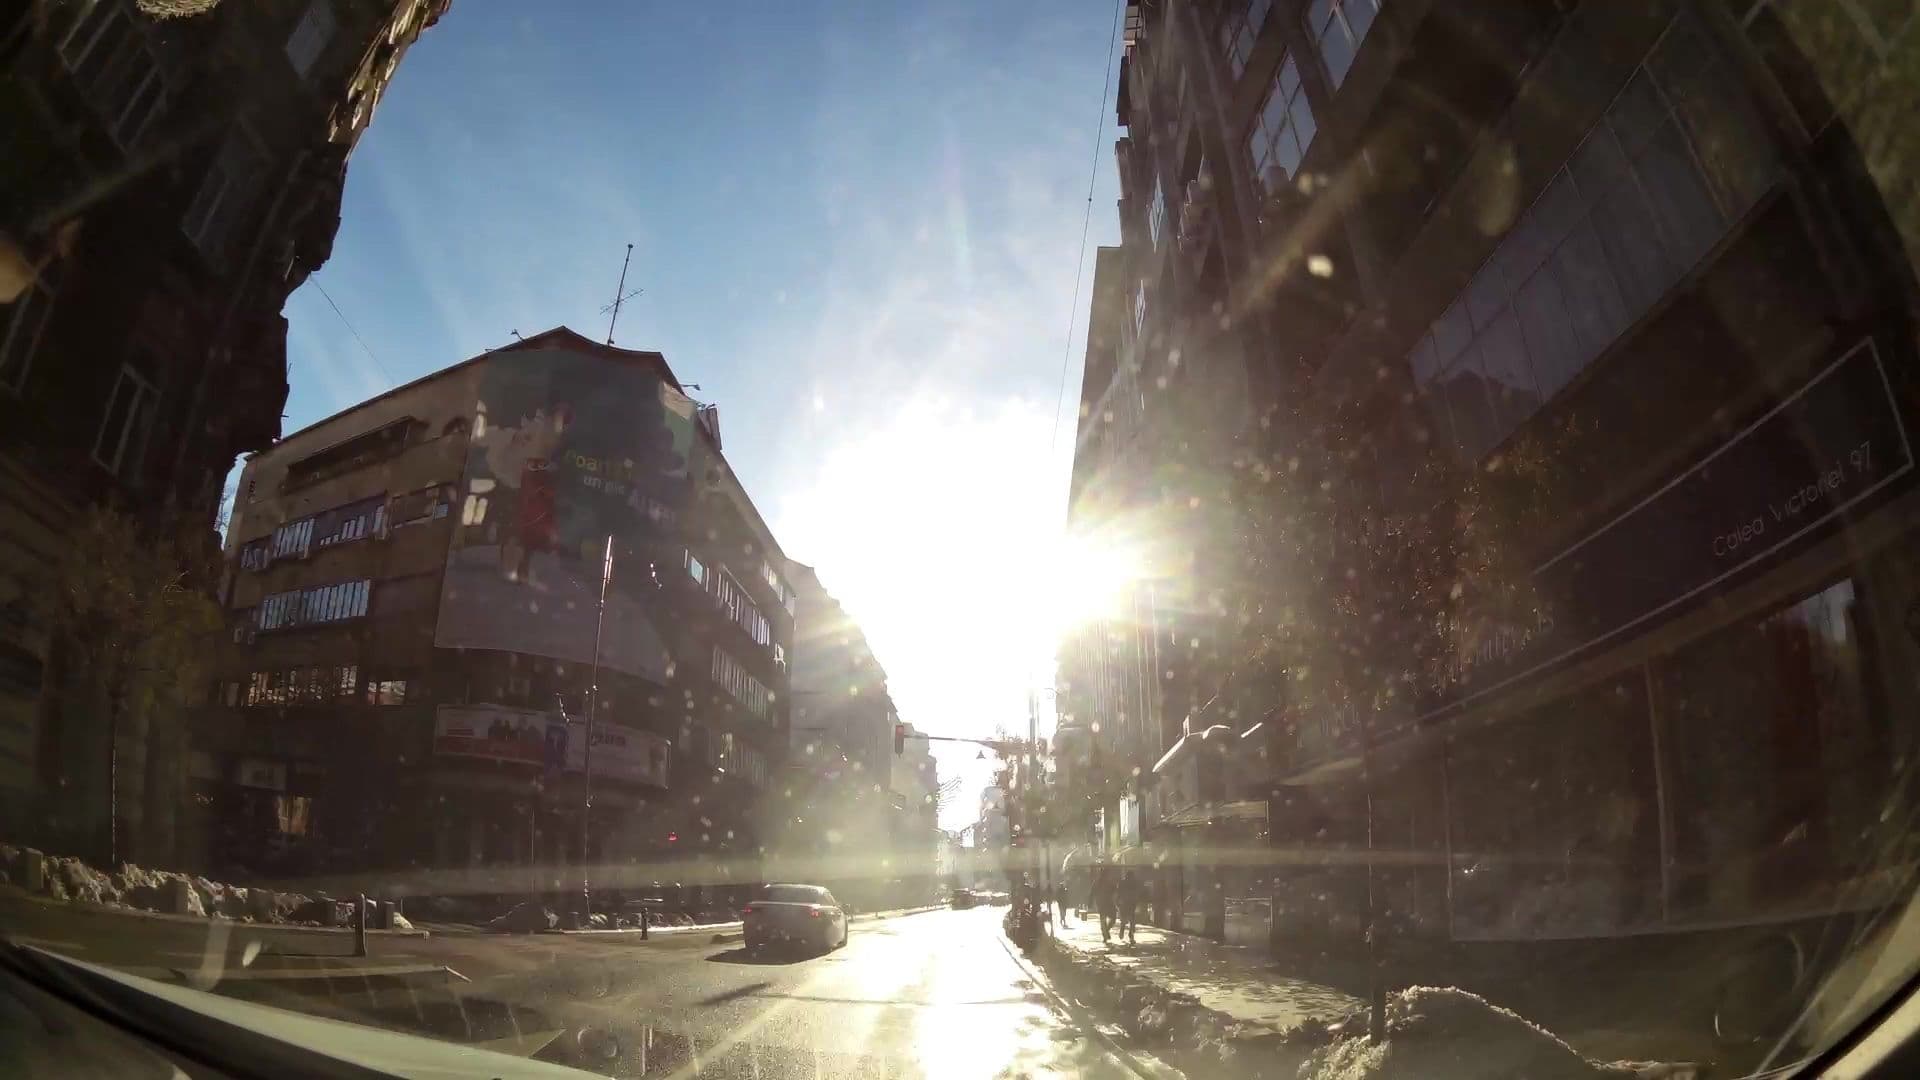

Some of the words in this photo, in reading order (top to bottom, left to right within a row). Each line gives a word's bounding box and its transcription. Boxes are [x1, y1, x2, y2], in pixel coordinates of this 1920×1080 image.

[1713, 516, 1763, 556] Calea
[1768, 460, 1847, 521] Victoriei
[1849, 440, 1873, 473] 97
